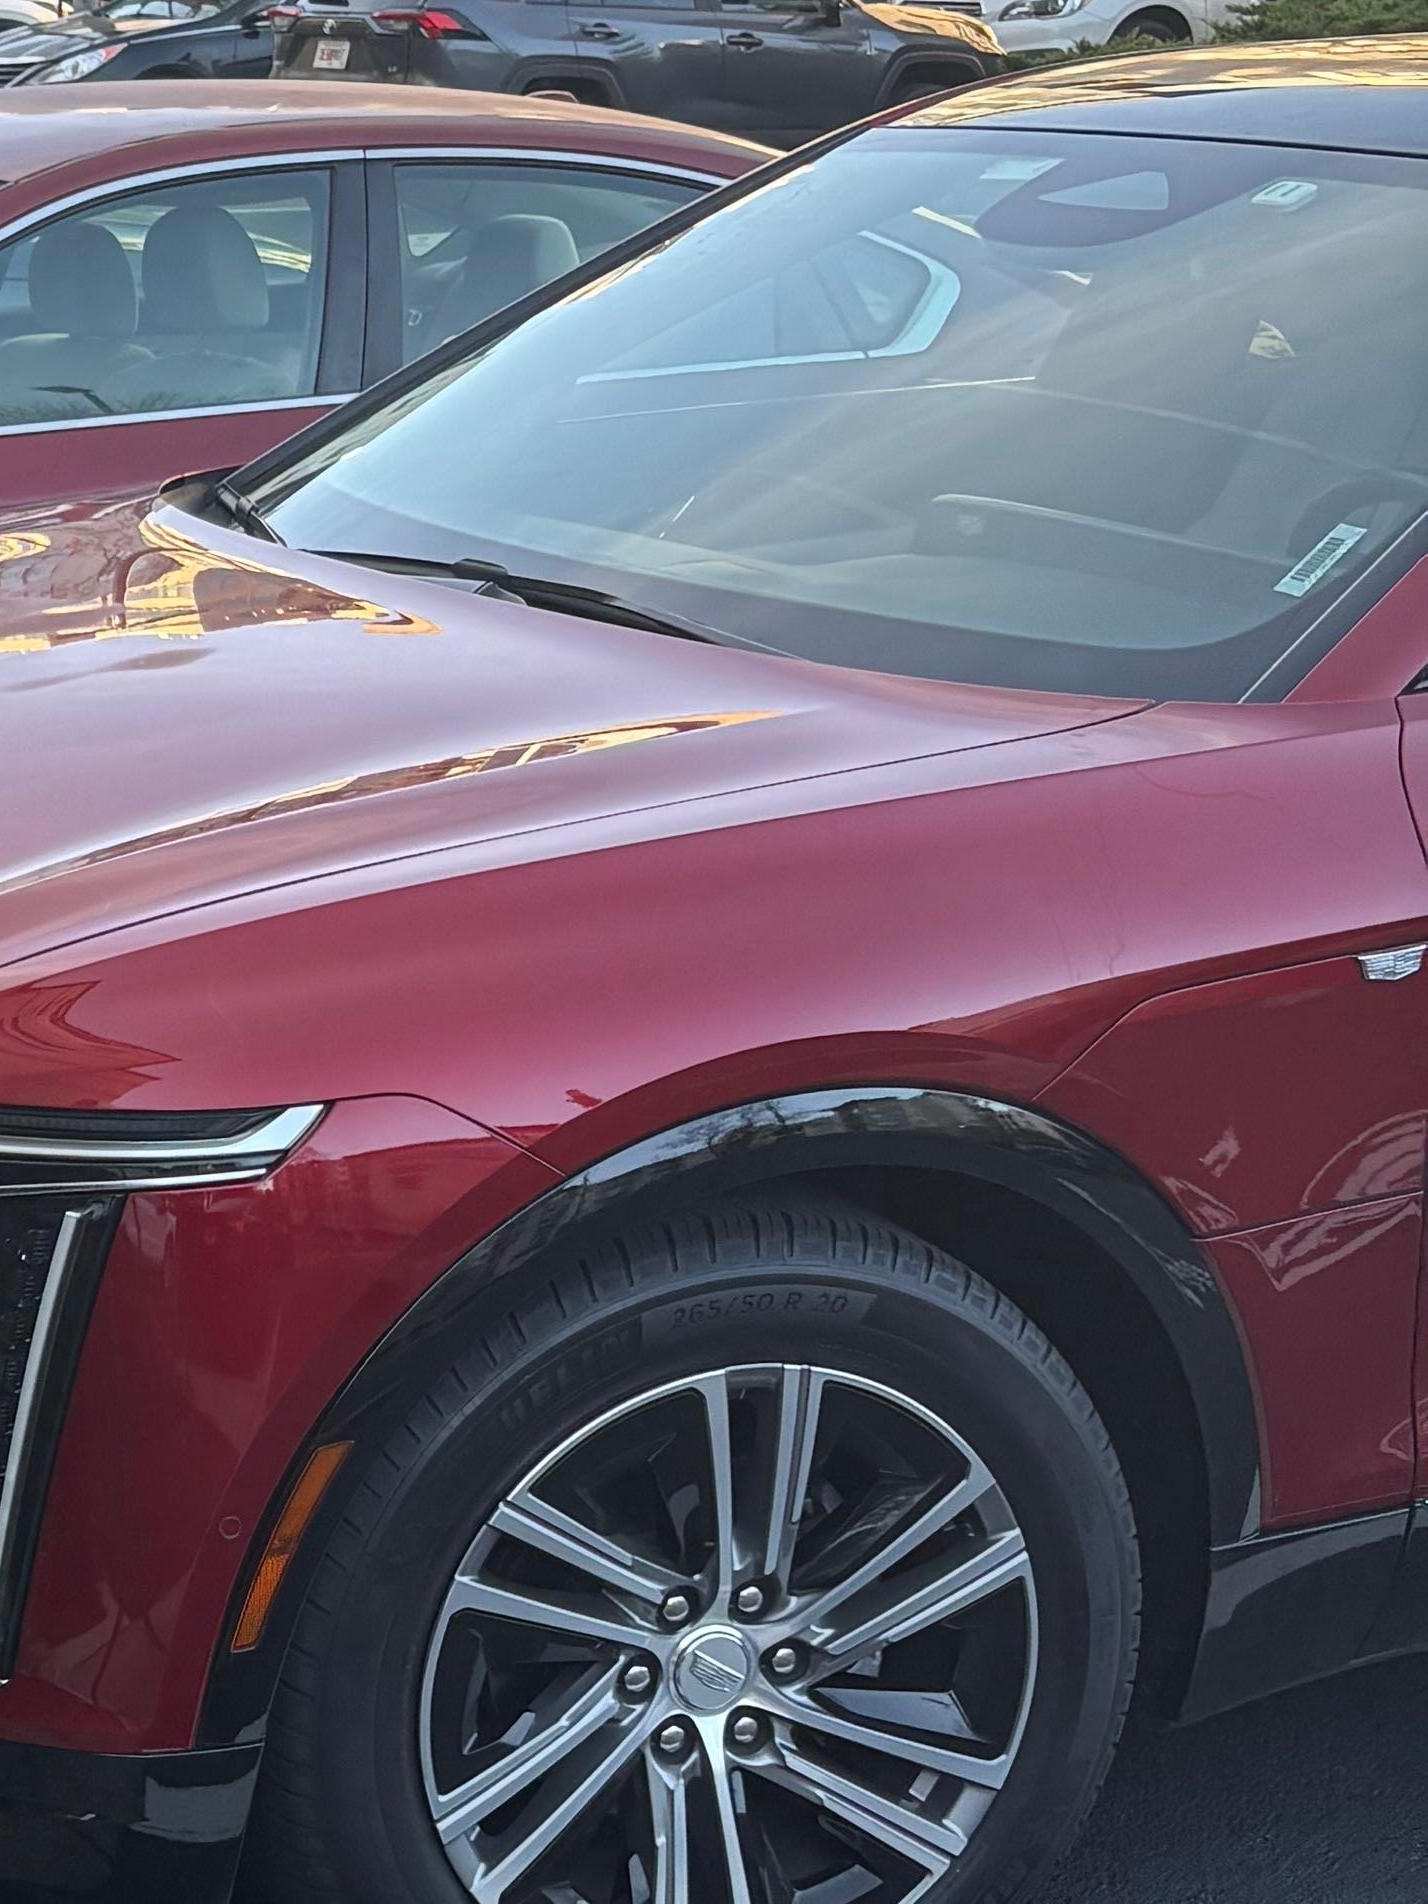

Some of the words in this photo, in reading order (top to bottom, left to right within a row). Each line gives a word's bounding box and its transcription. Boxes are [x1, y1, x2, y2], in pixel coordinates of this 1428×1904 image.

[671, 1292, 775, 1329] 265/50
[784, 1291, 802, 1311] R
[811, 1291, 849, 1314] 20
